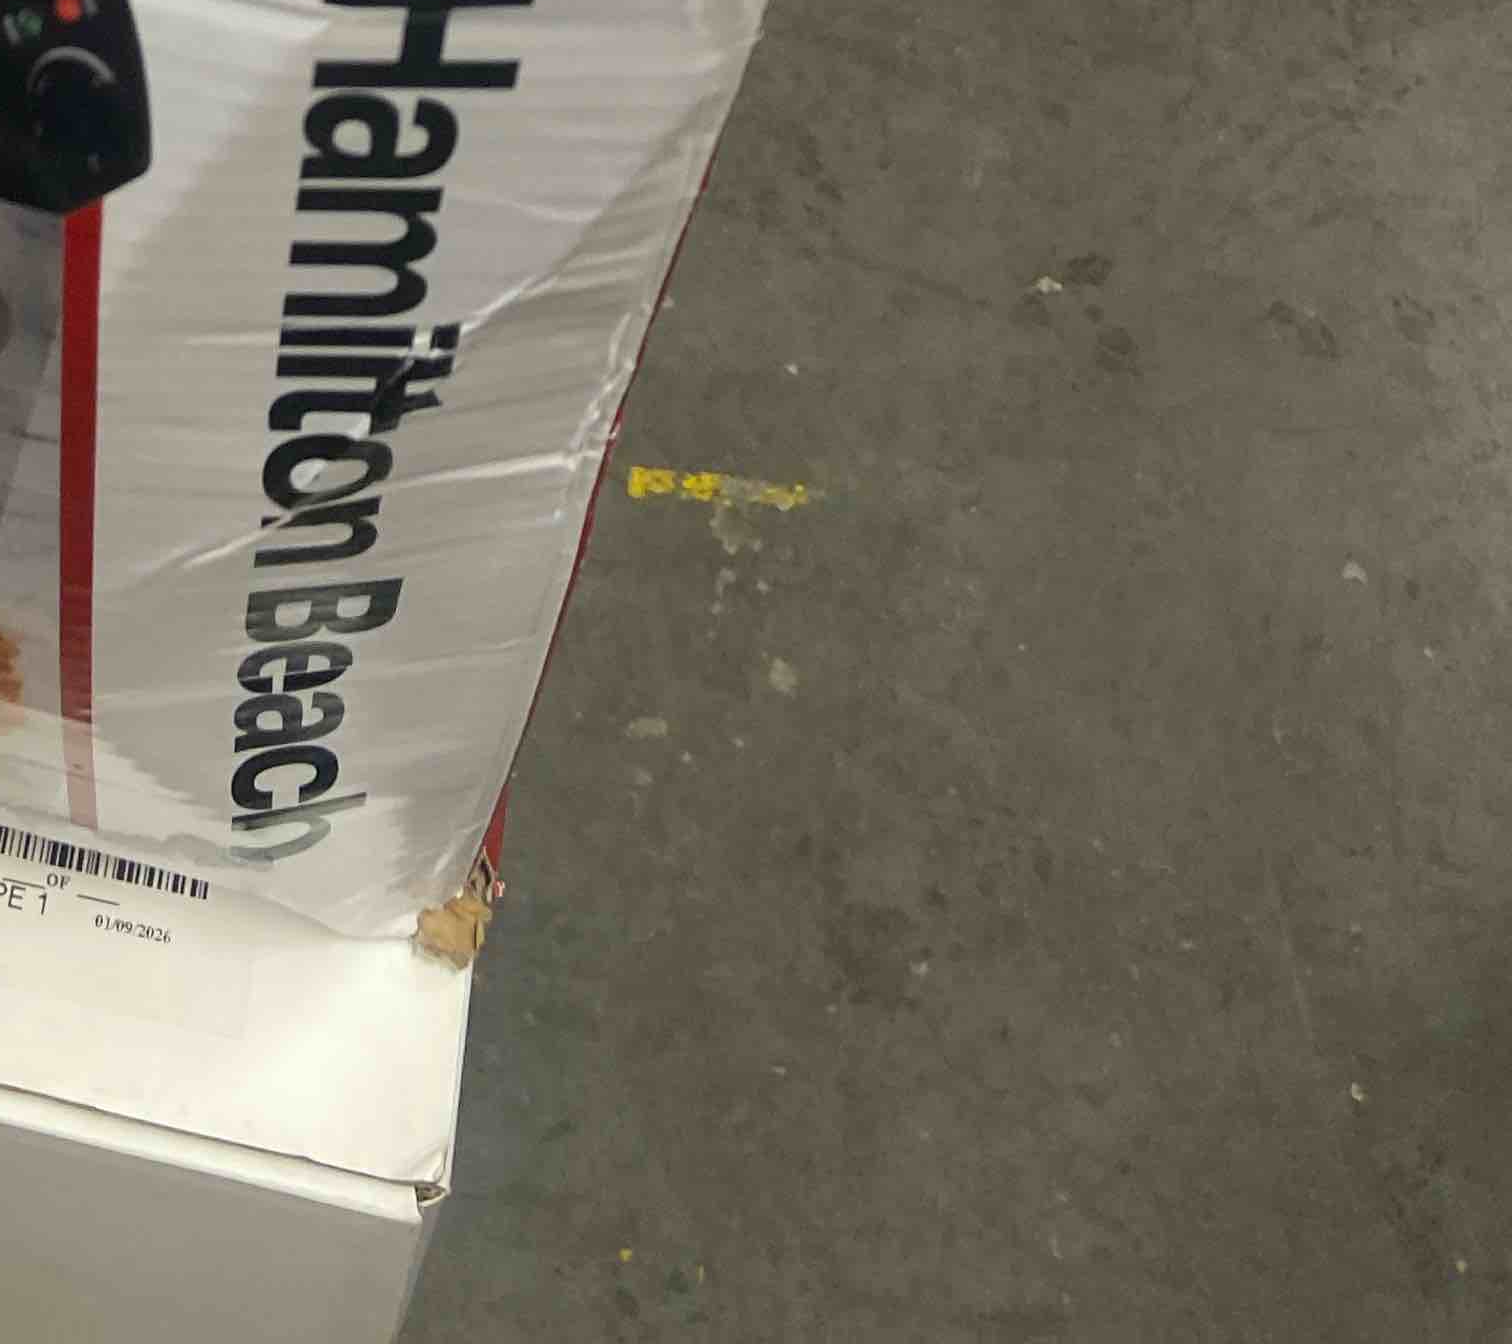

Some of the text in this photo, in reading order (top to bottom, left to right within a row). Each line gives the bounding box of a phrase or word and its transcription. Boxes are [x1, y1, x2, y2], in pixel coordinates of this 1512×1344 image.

[230, 575, 404, 865] Beach
[46, 873, 72, 891] OF
[37, 893, 49, 916] 1
[94, 914, 173, 945] 01/09/2026
